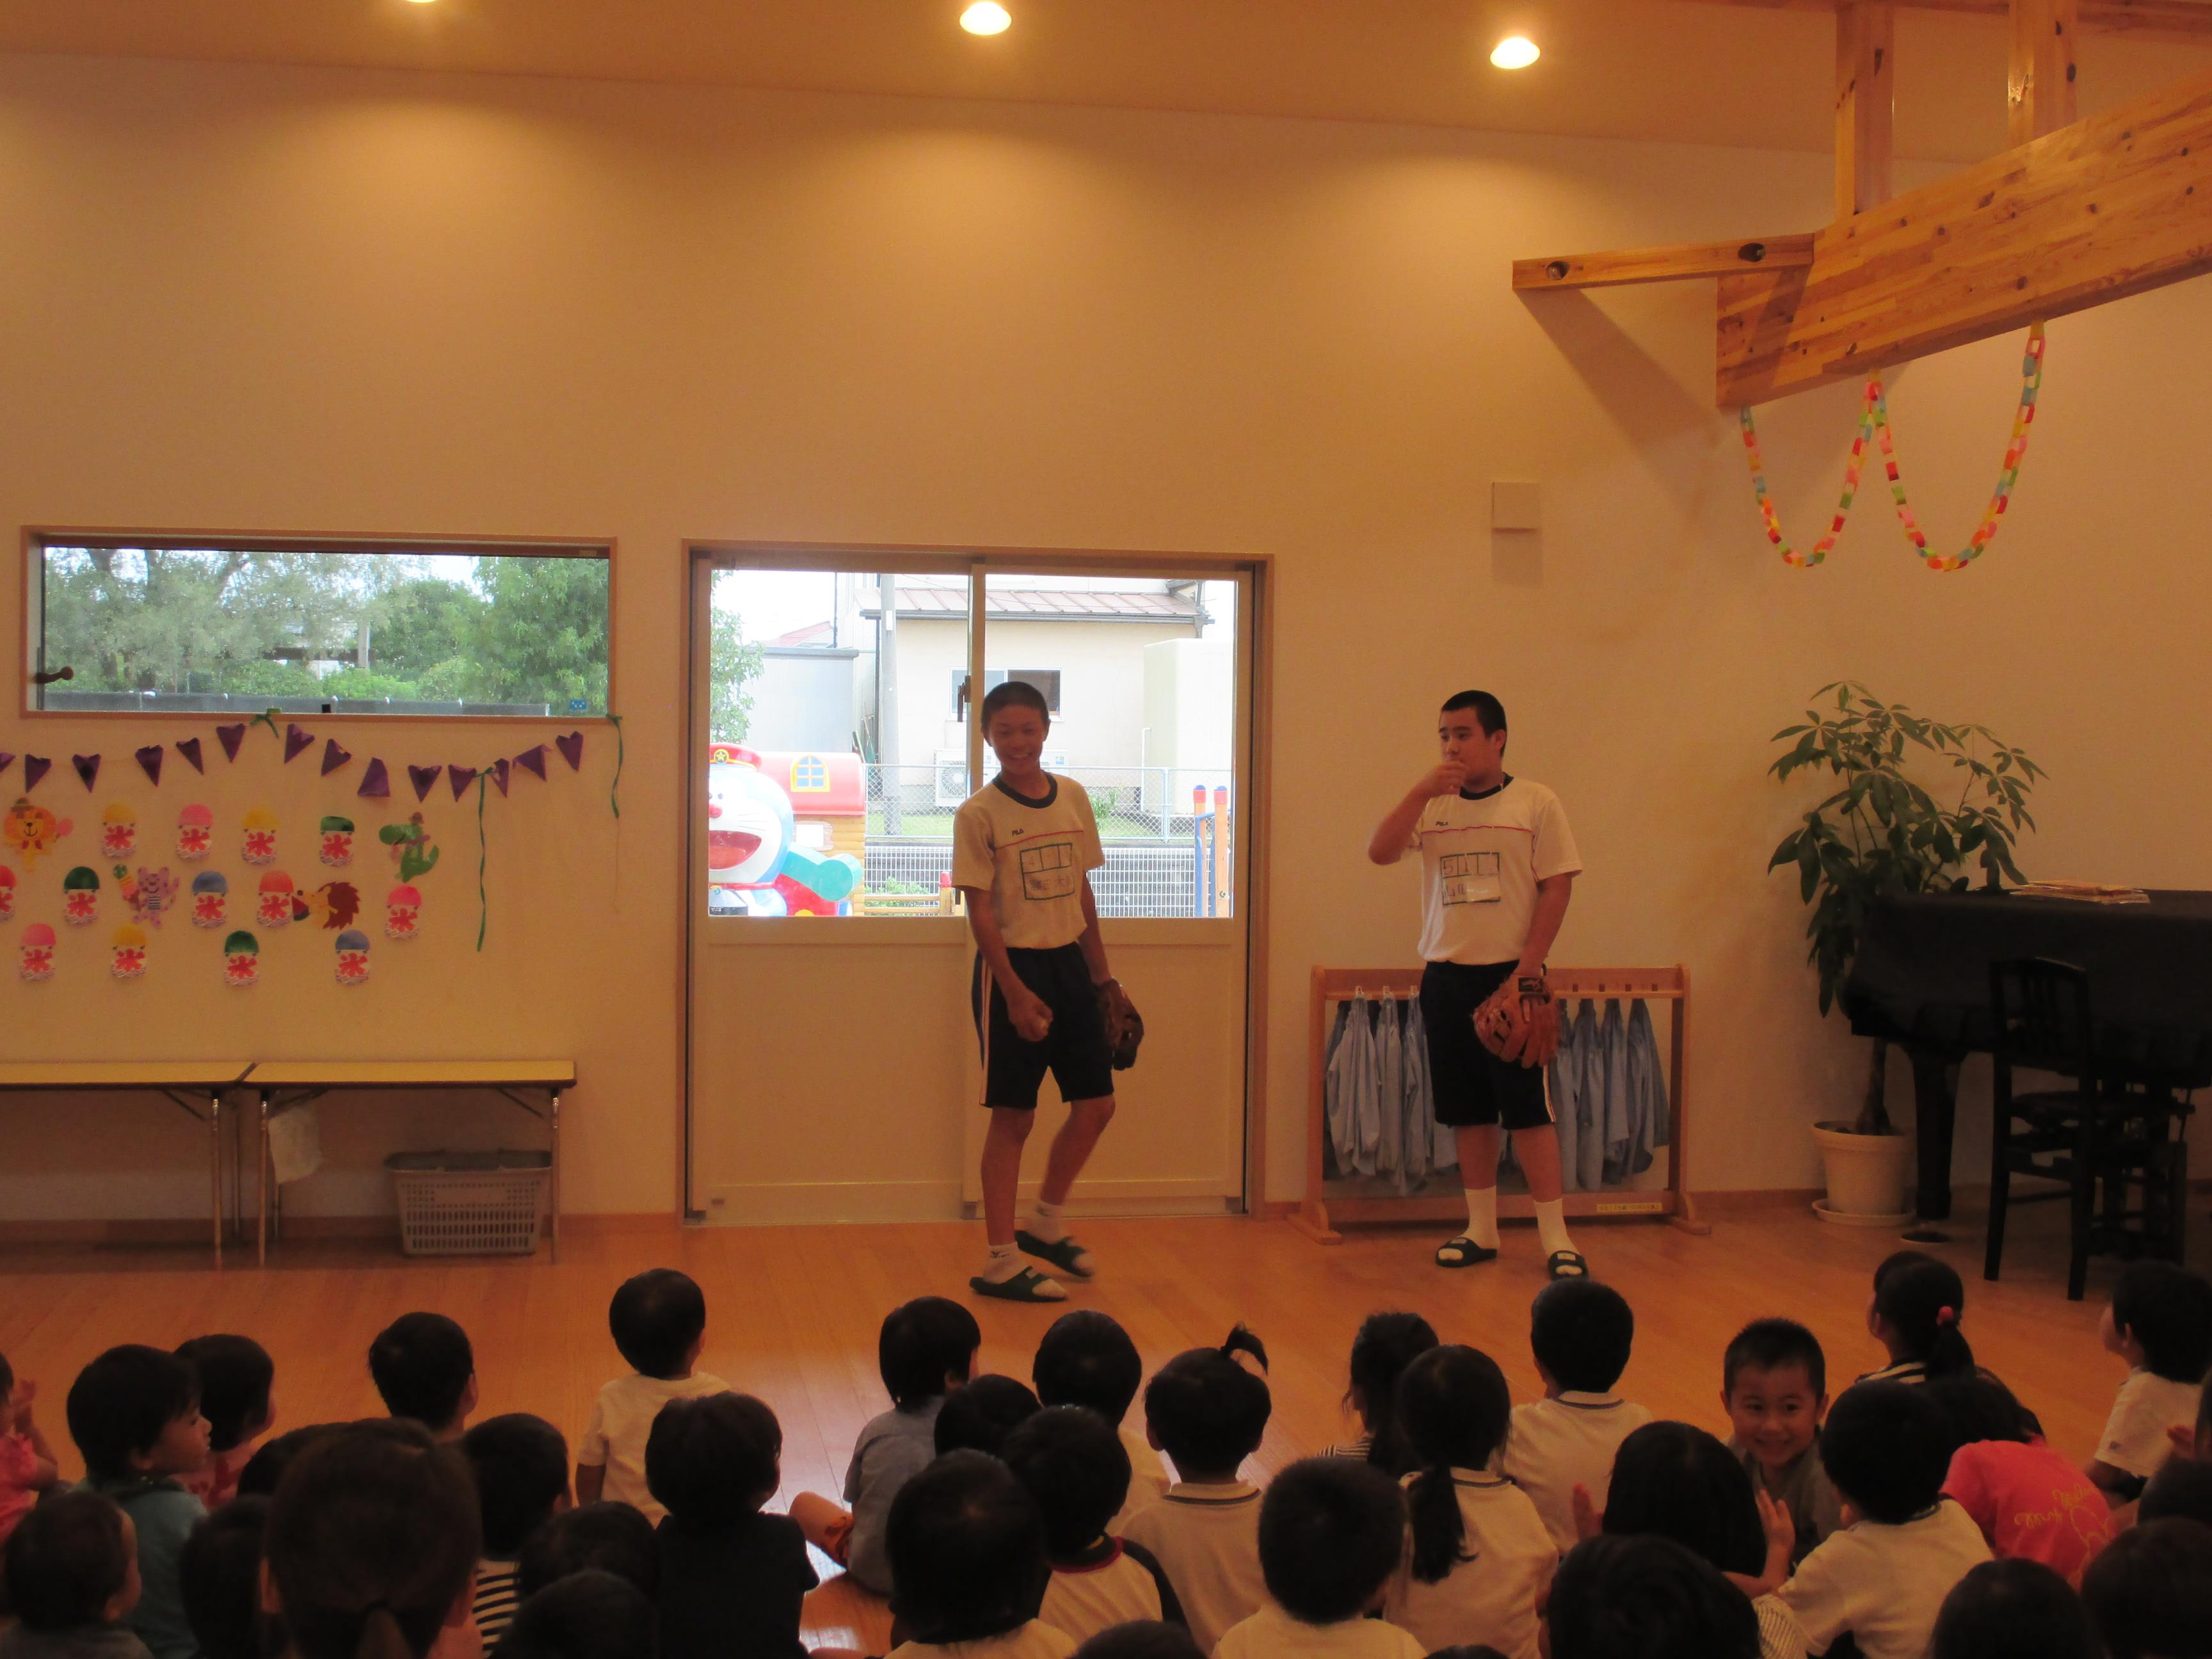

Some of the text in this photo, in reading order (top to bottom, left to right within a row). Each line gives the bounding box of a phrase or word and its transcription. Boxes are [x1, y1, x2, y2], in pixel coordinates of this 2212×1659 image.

[104, 825, 134, 849] 氷
[180, 828, 209, 851] 氷
[246, 832, 275, 856] 氷
[323, 834, 351, 858] 氷
[67, 893, 96, 917] 氷
[195, 895, 225, 919] 氷
[260, 895, 289, 920] 氷
[389, 908, 417, 932] 氷
[23, 949, 52, 973] 氷
[115, 949, 145, 971] 氷
[228, 956, 256, 979] 氷
[339, 953, 367, 977] 氷
